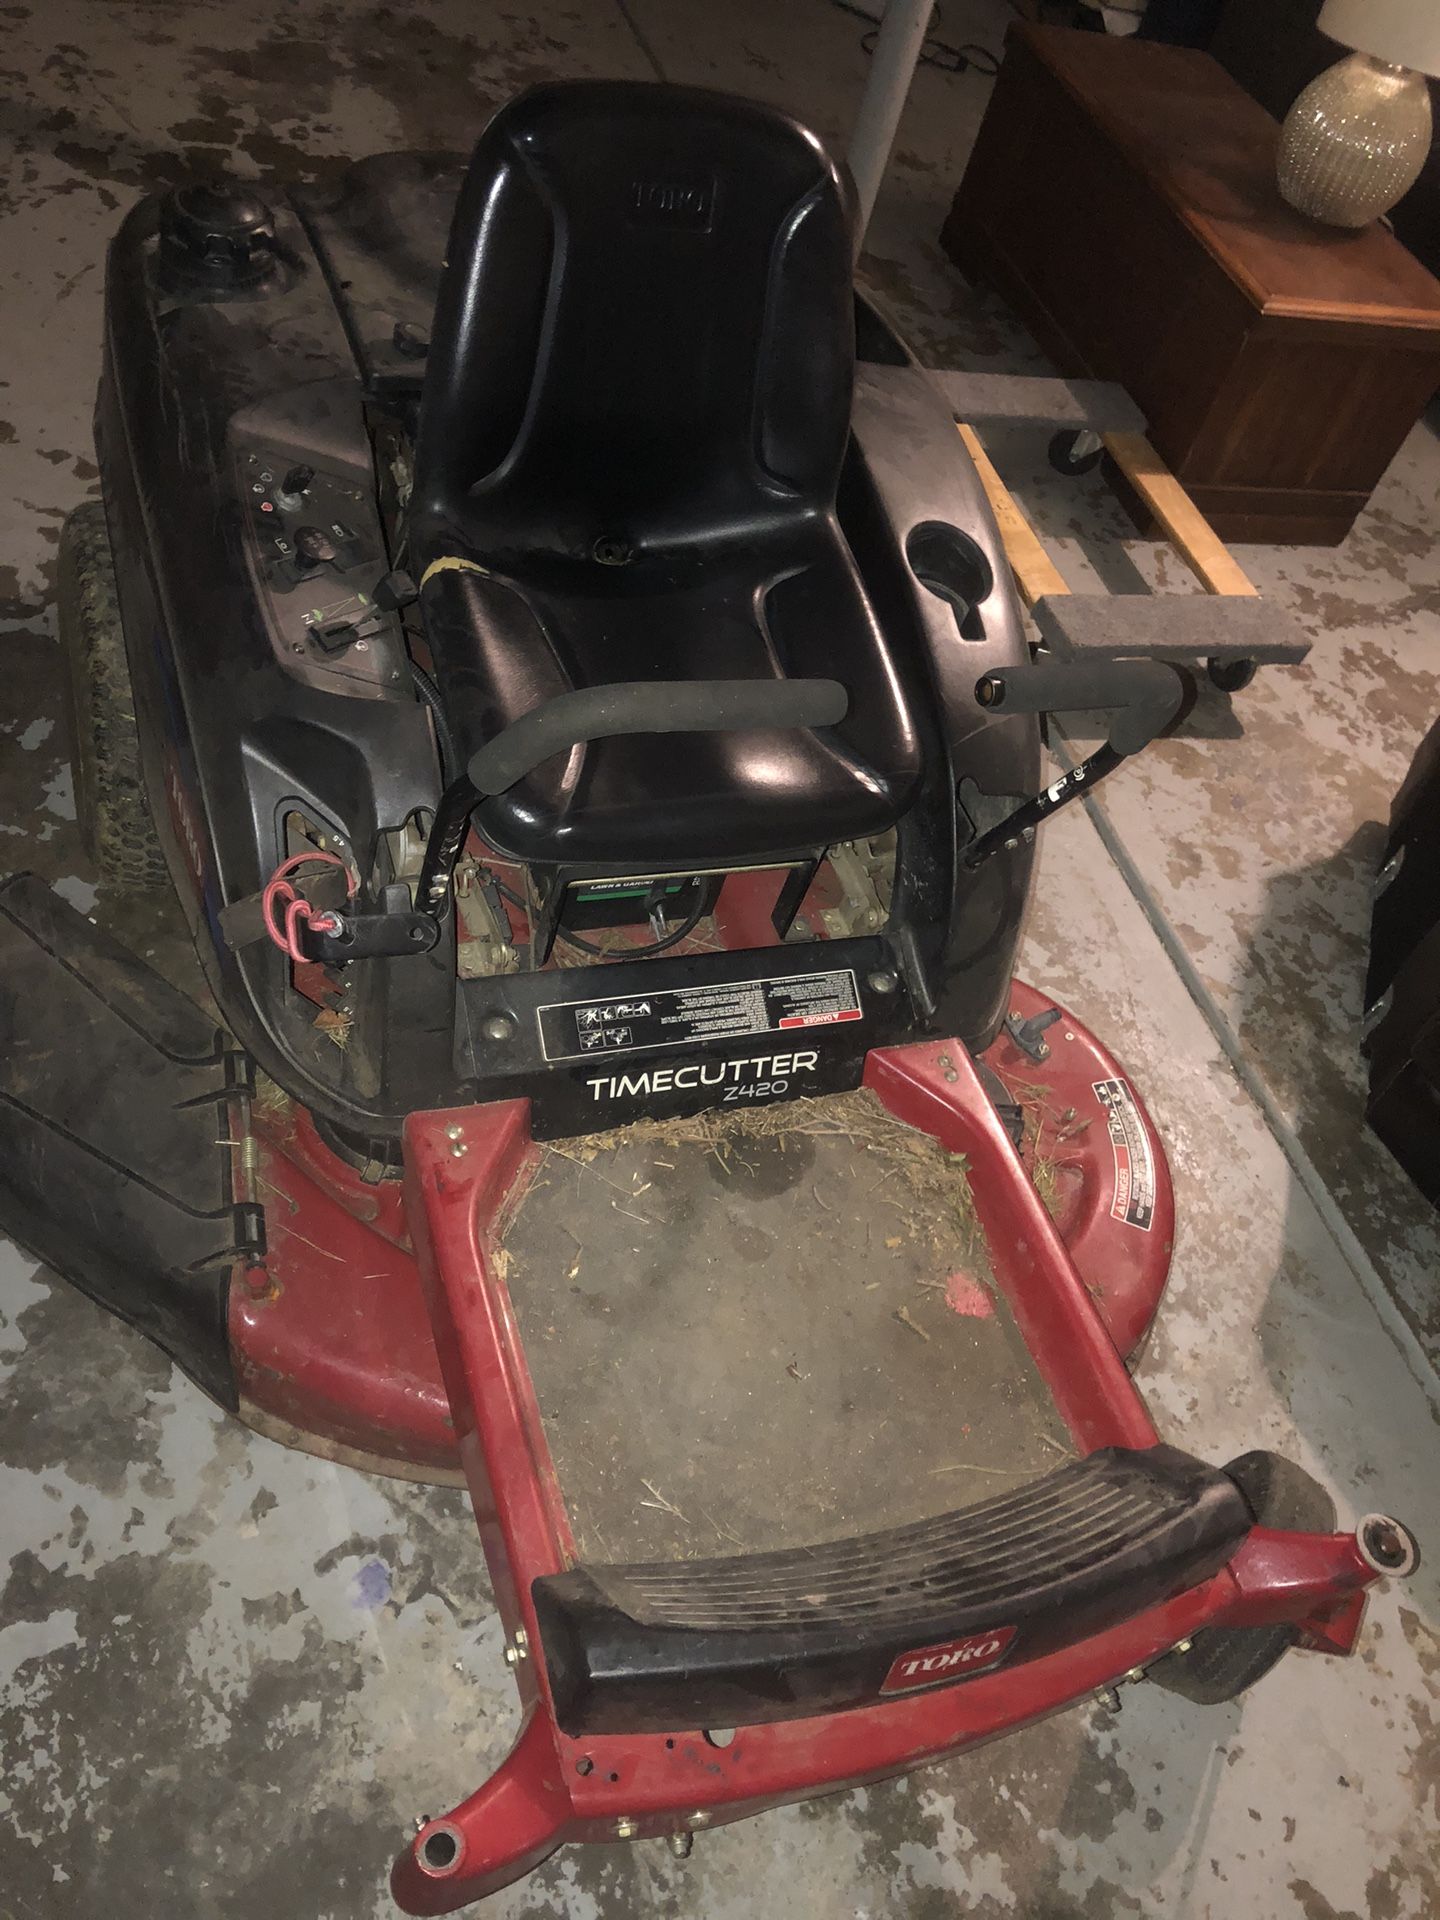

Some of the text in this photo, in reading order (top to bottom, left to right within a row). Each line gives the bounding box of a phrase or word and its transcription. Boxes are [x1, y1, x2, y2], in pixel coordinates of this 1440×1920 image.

[802, 1014, 833, 1025] DANGER
[586, 1051, 818, 1102] TIMECUTTER
[722, 1080, 788, 1102] Z420
[1117, 1168, 1129, 1208] DANGER
[901, 1640, 1000, 1677] TORO
